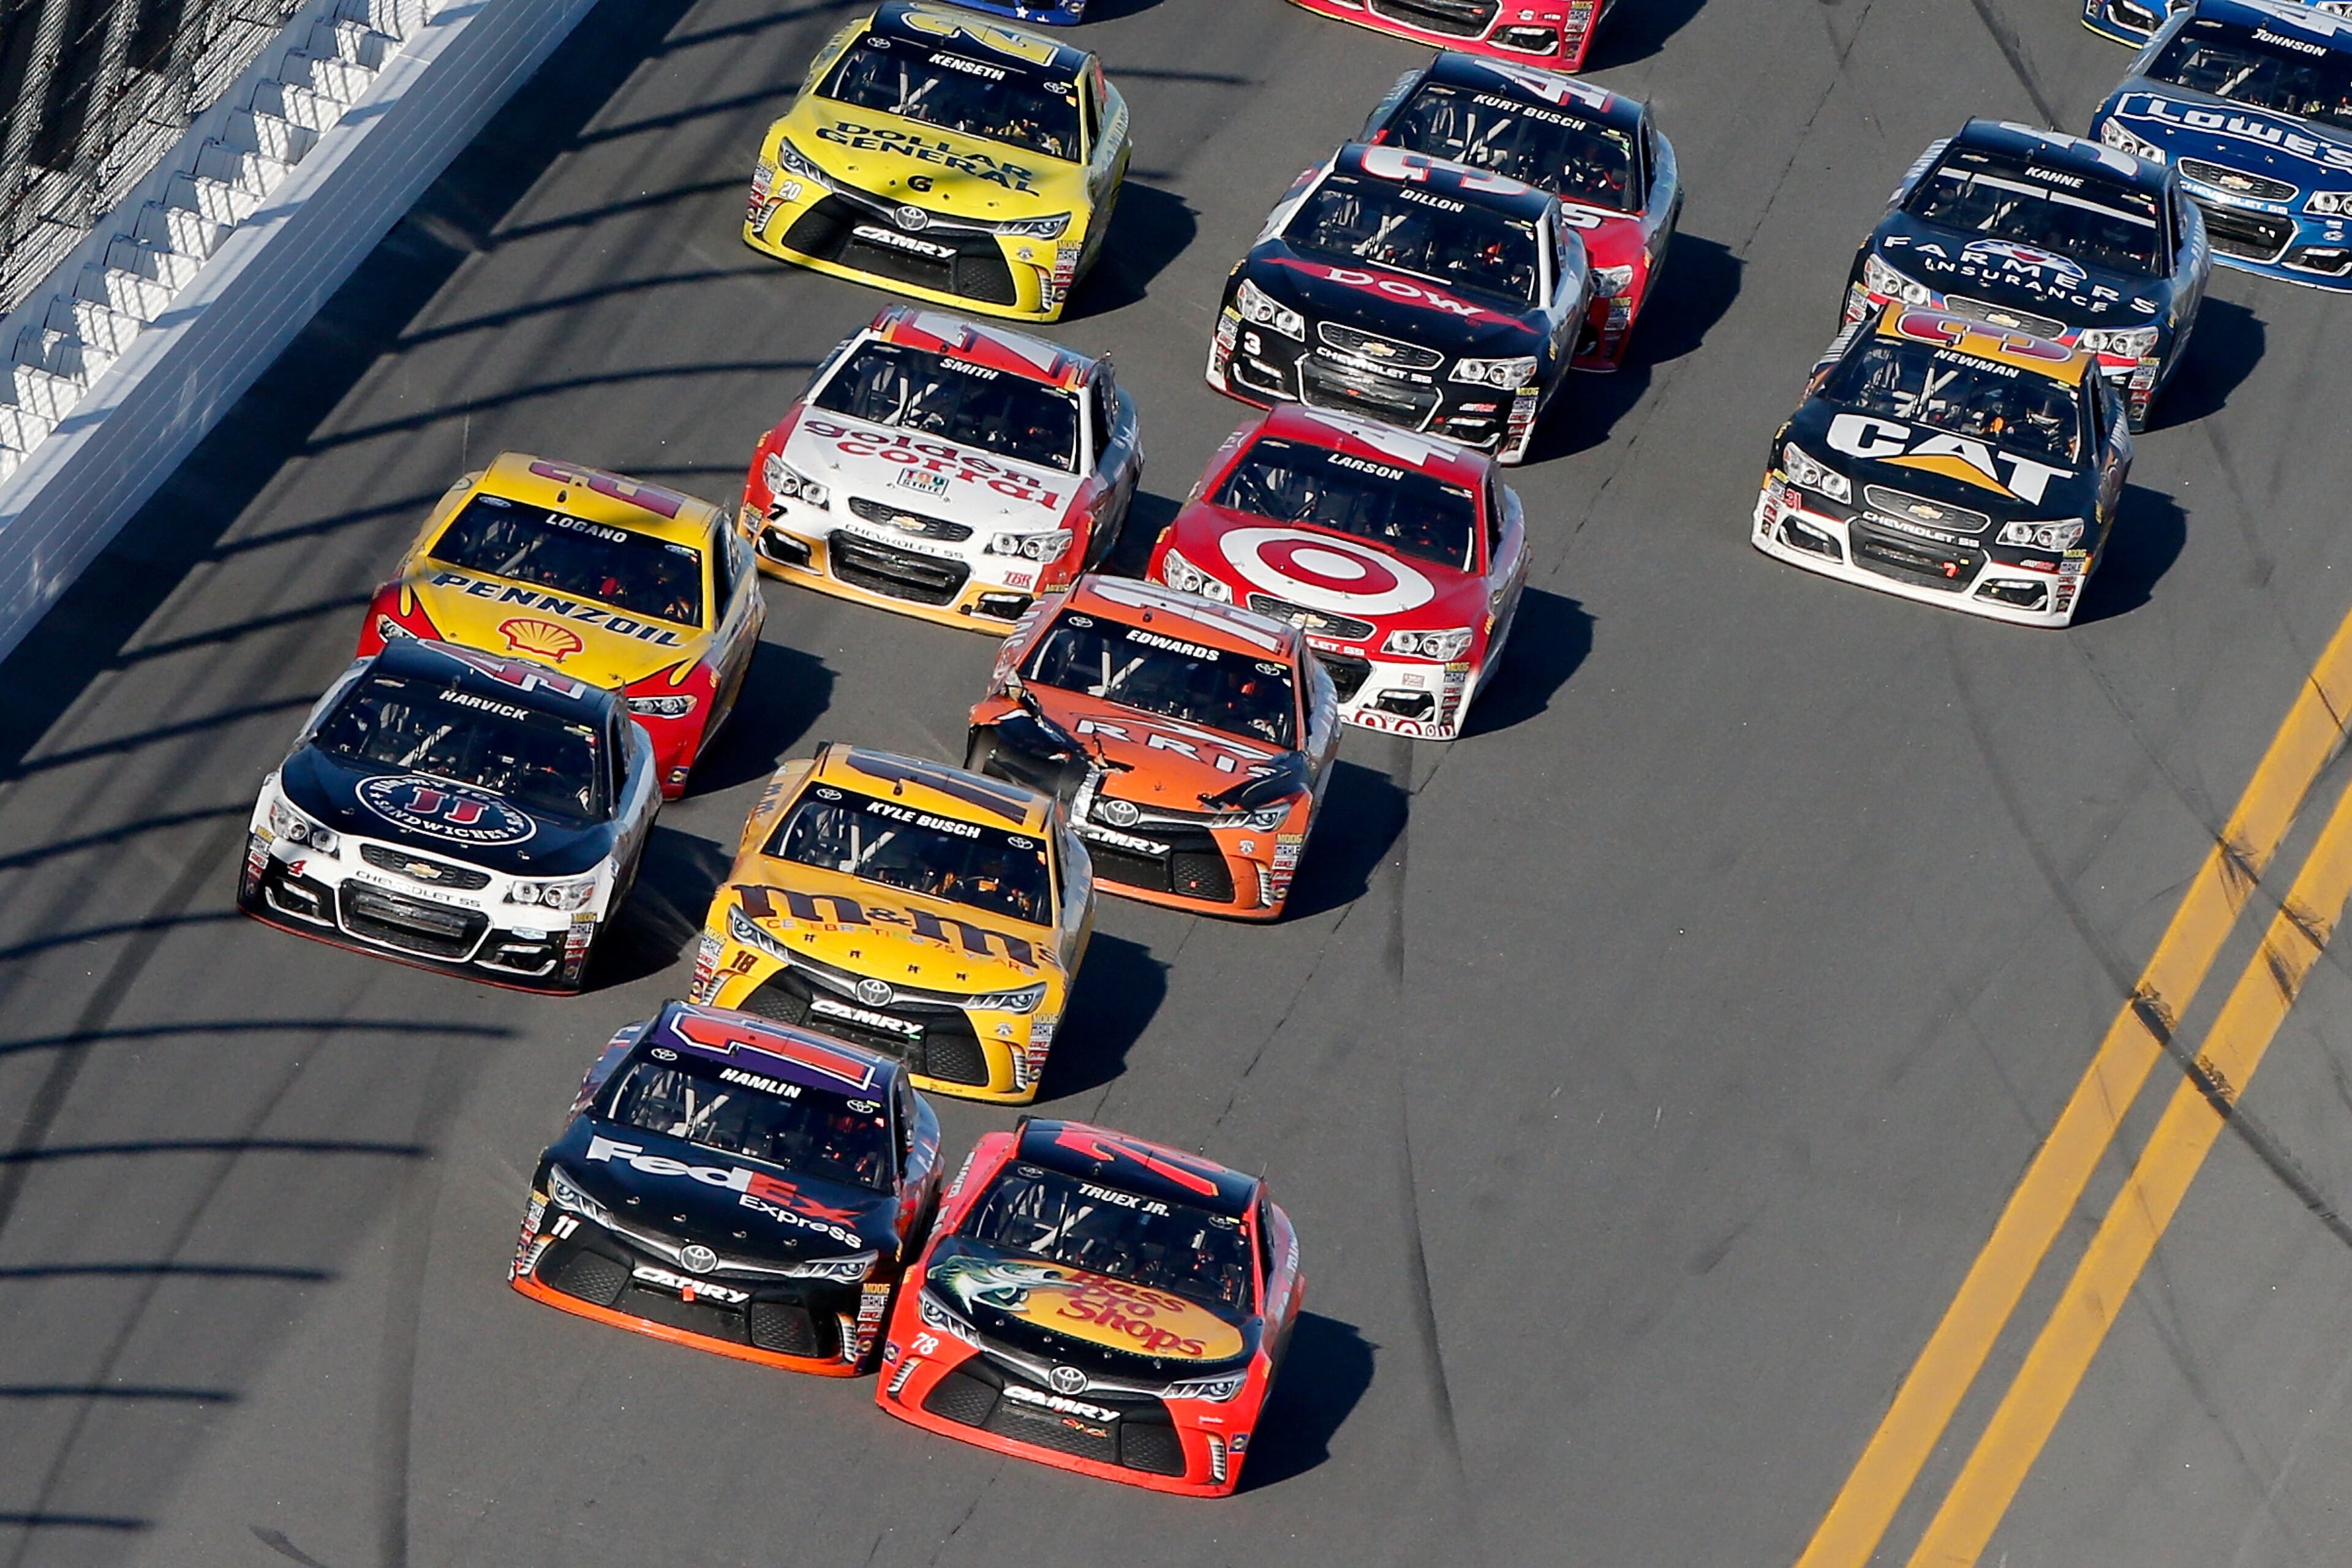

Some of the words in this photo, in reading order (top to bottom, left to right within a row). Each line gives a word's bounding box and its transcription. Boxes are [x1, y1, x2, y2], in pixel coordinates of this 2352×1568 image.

[2252, 28, 2327, 56] JOHNSON
[929, 53, 1005, 81] KENSETH
[1472, 94, 1523, 112] KURT
[1523, 107, 1587, 131] BUSCH
[2147, 99, 2352, 166] LOWE'S
[815, 127, 1039, 197] GENERAL
[835, 121, 1033, 181] DOLLAR
[778, 179, 802, 200] 20
[2026, 167, 2084, 189] KAHNE
[1399, 189, 1466, 213] DILLON
[852, 225, 957, 258] CAMRY
[1324, 267, 1485, 317] DOW
[1883, 236, 2157, 315] FARMERS
[1924, 258, 2108, 313] INSURANCE
[1244, 331, 1261, 355] 3
[938, 357, 1000, 381] SMITH
[1316, 346, 1408, 380] CHEVROLET
[1934, 349, 2020, 379] NEWMAN
[804, 420, 1042, 488] golden
[1327, 453, 1403, 481] LARSON
[1826, 413, 2075, 506] CAT
[836, 440, 1060, 511] corral
[767, 503, 788, 521] 7
[1785, 488, 1802, 510] 31
[545, 513, 628, 543] LOGANO
[845, 524, 938, 553] CHEVROLET
[1862, 511, 1955, 543] CHEVROLET
[1004, 570, 1033, 589] TBR
[431, 573, 686, 648] PENNZOIL
[1125, 629, 1221, 662] EDWARDS
[439, 689, 530, 722] HARVICK
[374, 799, 510, 840] SANDWICHES
[404, 786, 489, 824] JJ
[866, 801, 916, 823] KYLE
[917, 815, 981, 839] BUSCH
[287, 859, 308, 878] 4
[356, 870, 454, 902] CHEVROLET
[731, 950, 759, 974] 18
[933, 941, 956, 954] 75
[966, 949, 1035, 976] YEARS
[810, 1000, 924, 1038] CAMRY
[719, 1068, 802, 1099] HAMLIN
[586, 1134, 862, 1229] FedEx
[1078, 1183, 1140, 1210] TRUEX
[1141, 1197, 1170, 1216] JR.
[551, 1215, 579, 1240] 11
[738, 1194, 862, 1250] Express
[632, 1267, 750, 1303] CAMRY
[862, 1283, 891, 1294] MOOG
[1061, 1286, 1156, 1317] Pro
[1065, 1271, 1187, 1313] Bass
[911, 1332, 939, 1355] 78
[1057, 1300, 1207, 1355] Shops
[1003, 1385, 1121, 1422] CAMRY
